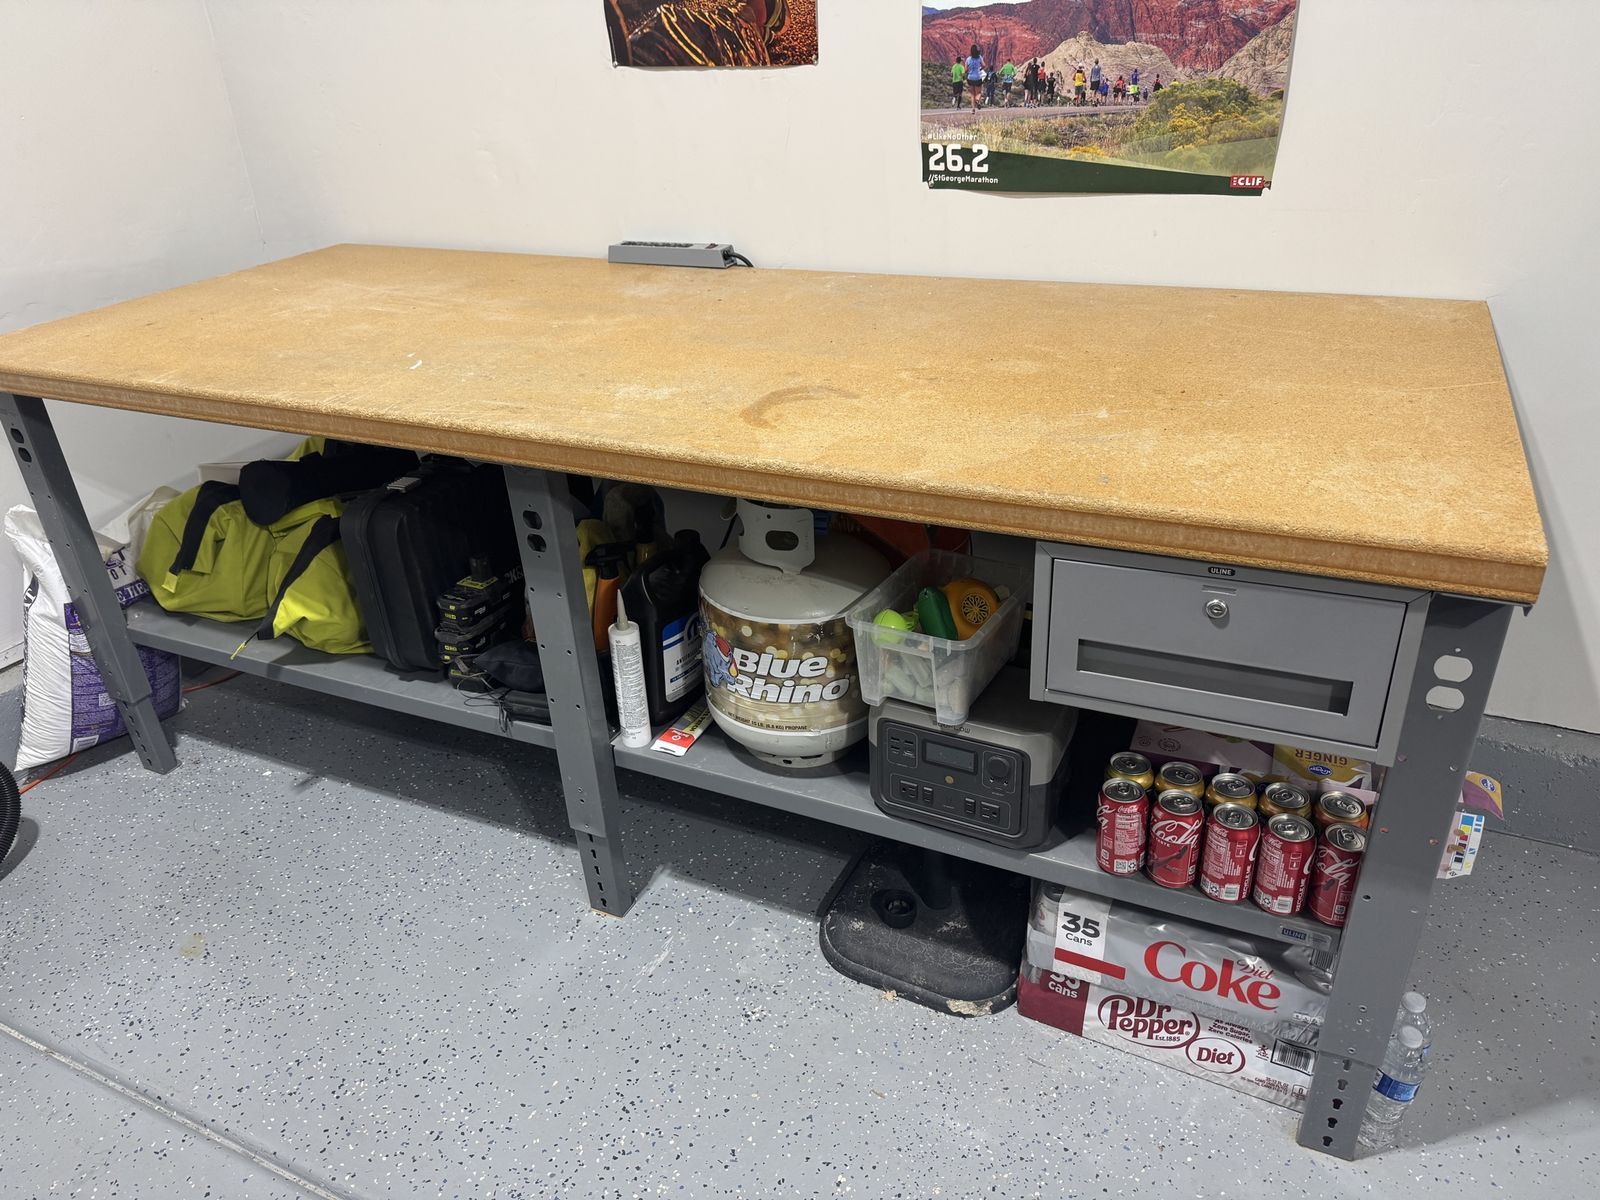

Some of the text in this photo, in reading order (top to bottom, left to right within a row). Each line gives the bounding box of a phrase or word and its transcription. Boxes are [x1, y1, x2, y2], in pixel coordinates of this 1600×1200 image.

[928, 143, 989, 173] 26.2
[1237, 176, 1263, 186] CLIF
[1210, 567, 1232, 576] ULINE
[733, 647, 829, 679] Blue
[727, 674, 851, 704] Rhino
[735, 714, 751, 724] WEIGHT
[1295, 748, 1348, 766] GINGER
[1061, 911, 1101, 940] 35
[1283, 929, 1305, 940] ULINE
[1065, 932, 1093, 947] Cans
[1144, 940, 1281, 1011] Coke
[1237, 958, 1276, 980] Diet
[1048, 981, 1078, 999] cans
[1135, 996, 1172, 1019] Dr
[1107, 1000, 1194, 1040] Pepper
[1212, 1022, 1229, 1031] Zero
[1208, 1026, 1253, 1044] Zero Calories
[1196, 1046, 1236, 1065] Diet
